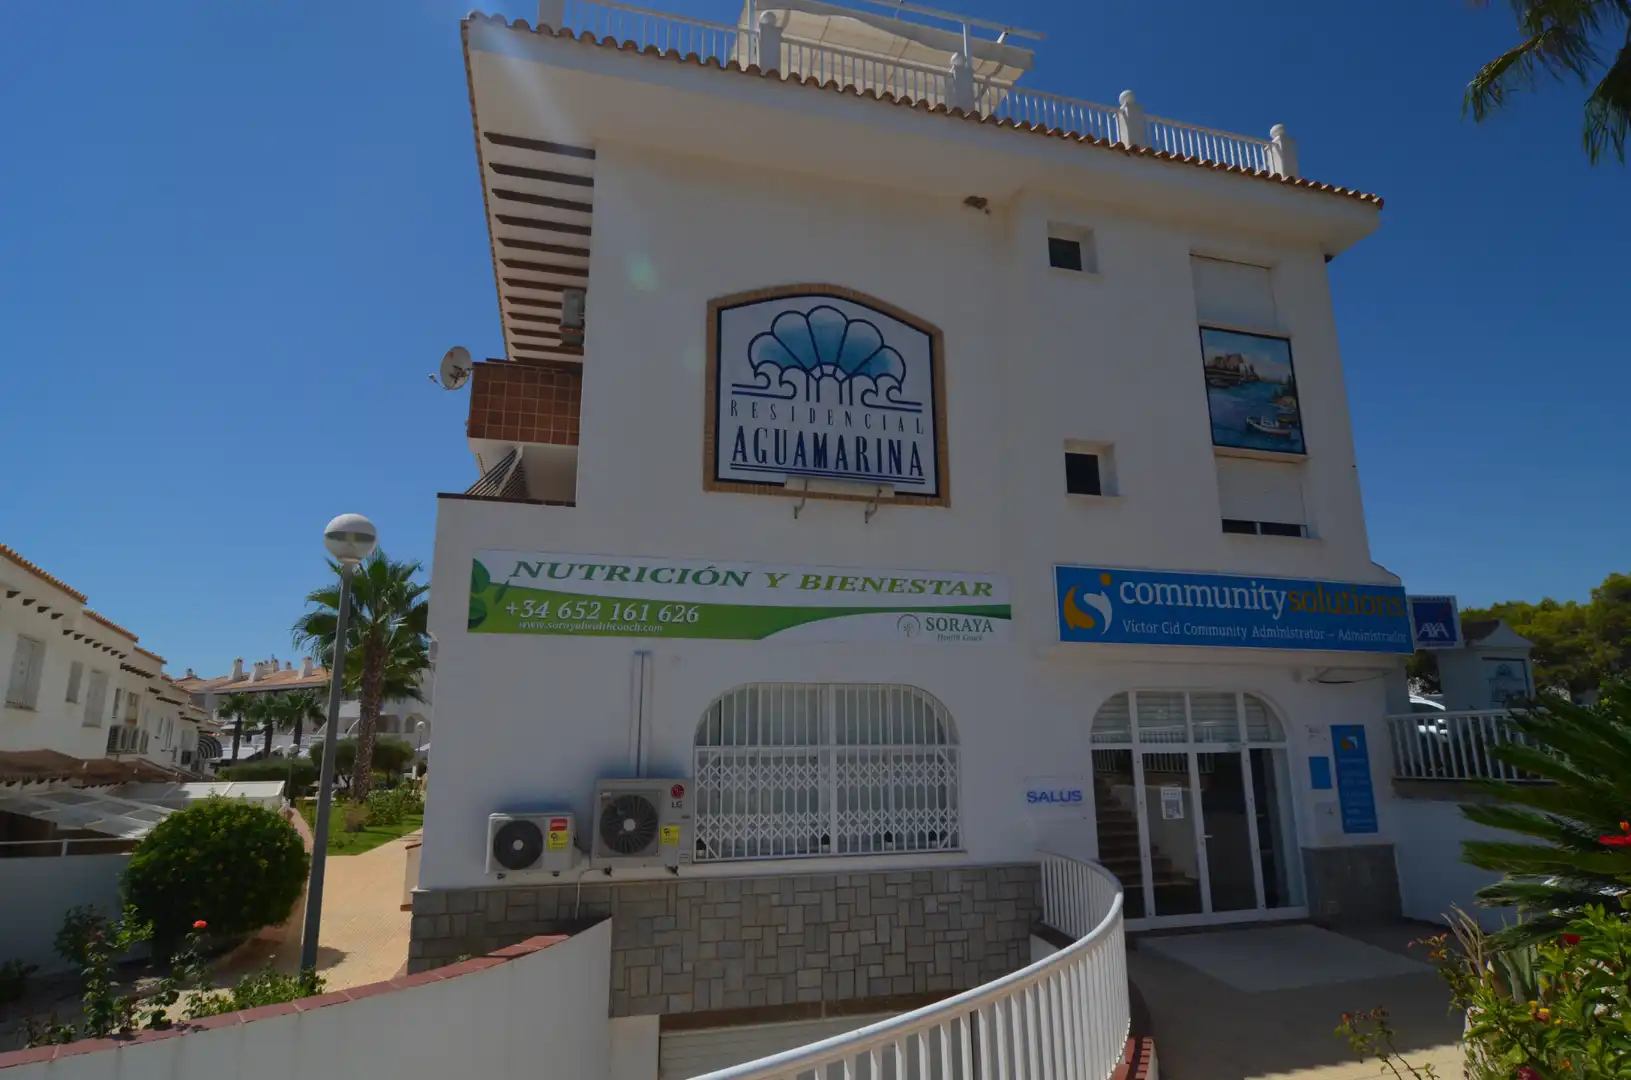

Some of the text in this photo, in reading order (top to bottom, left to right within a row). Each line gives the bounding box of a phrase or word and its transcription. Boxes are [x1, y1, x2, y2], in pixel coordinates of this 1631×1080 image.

[730, 400, 924, 435] RESIDENCIAL
[731, 425, 924, 477] AGUAMARINA
[508, 560, 993, 597] NUTRICIÓN Y BIENESTAR
[505, 599, 700, 624] +34 652 161 626
[926, 616, 994, 633] SORAYA
[1183, 622, 1248, 642] Community
[1251, 624, 1325, 640] Administrator
[1416, 621, 1450, 640] AXA
[670, 800, 683, 809] LG
[1026, 789, 1083, 804] SALUS
